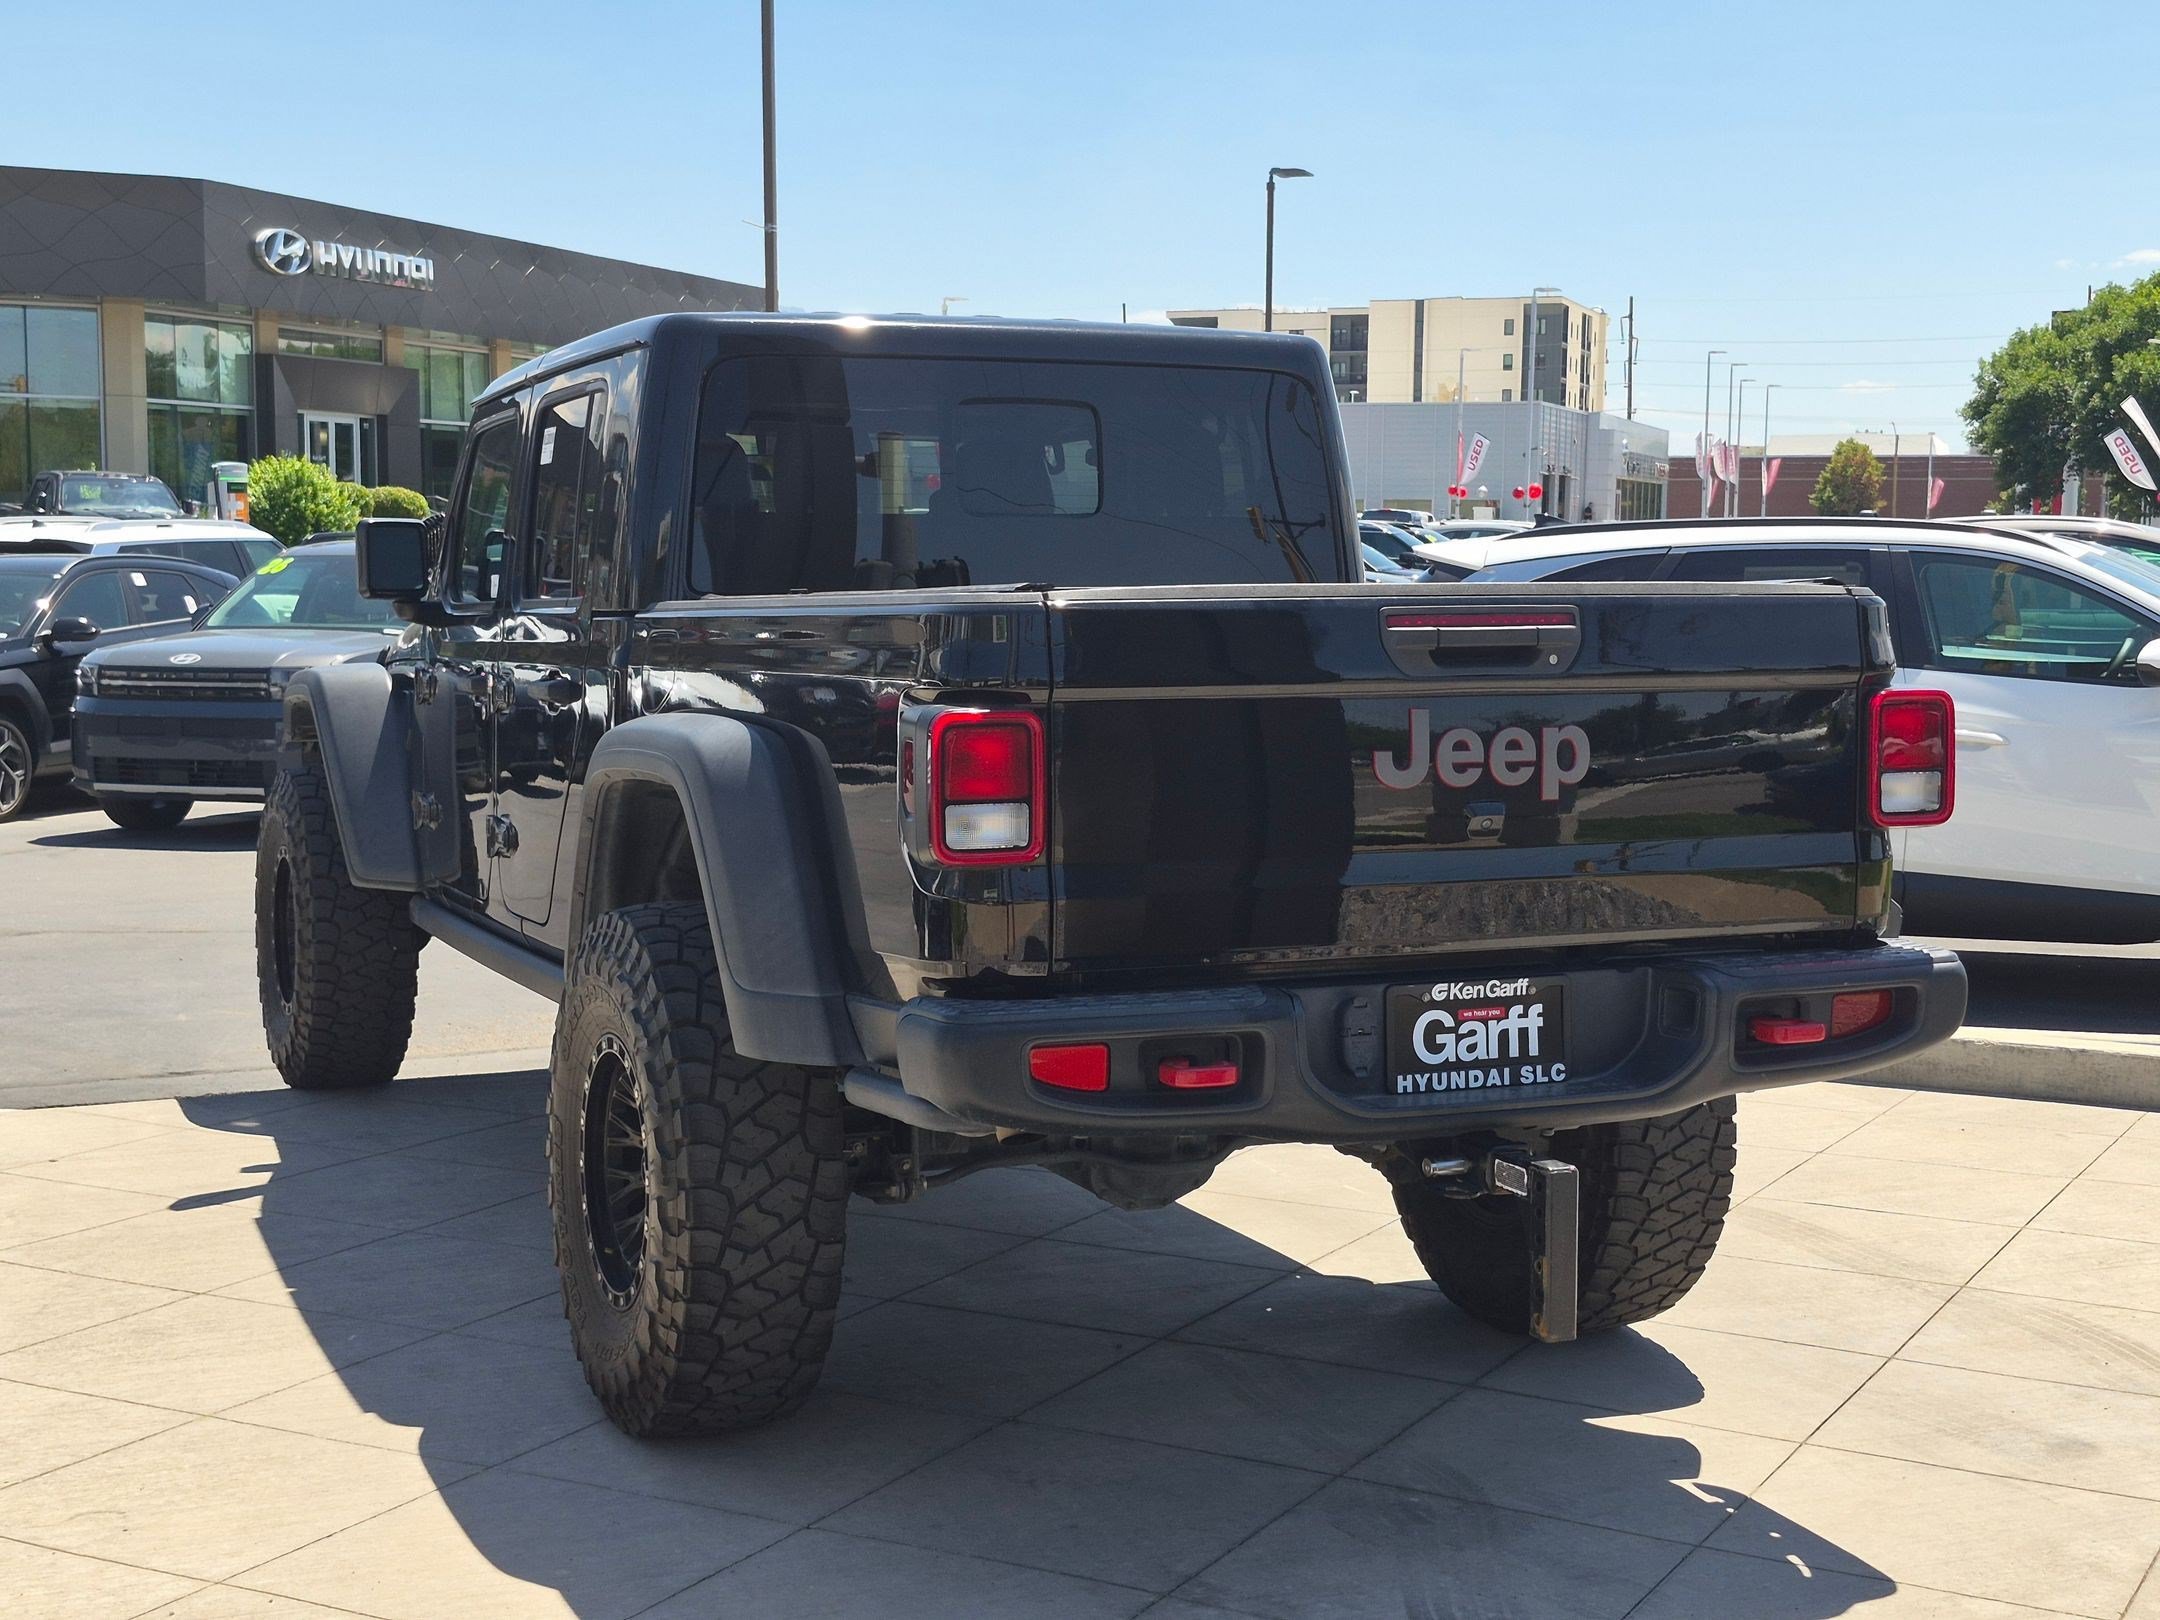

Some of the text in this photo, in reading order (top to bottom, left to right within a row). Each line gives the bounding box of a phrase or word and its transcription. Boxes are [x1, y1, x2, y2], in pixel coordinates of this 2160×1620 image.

[316, 240, 434, 284] HYUNDAI
[1467, 439, 1484, 471] USED
[1372, 708, 1591, 802] Jeep
[1488, 1009, 1501, 1017] you
[1412, 1003, 1544, 1065] Garff
[1397, 1062, 1566, 1094] HYUNDAI SLC
